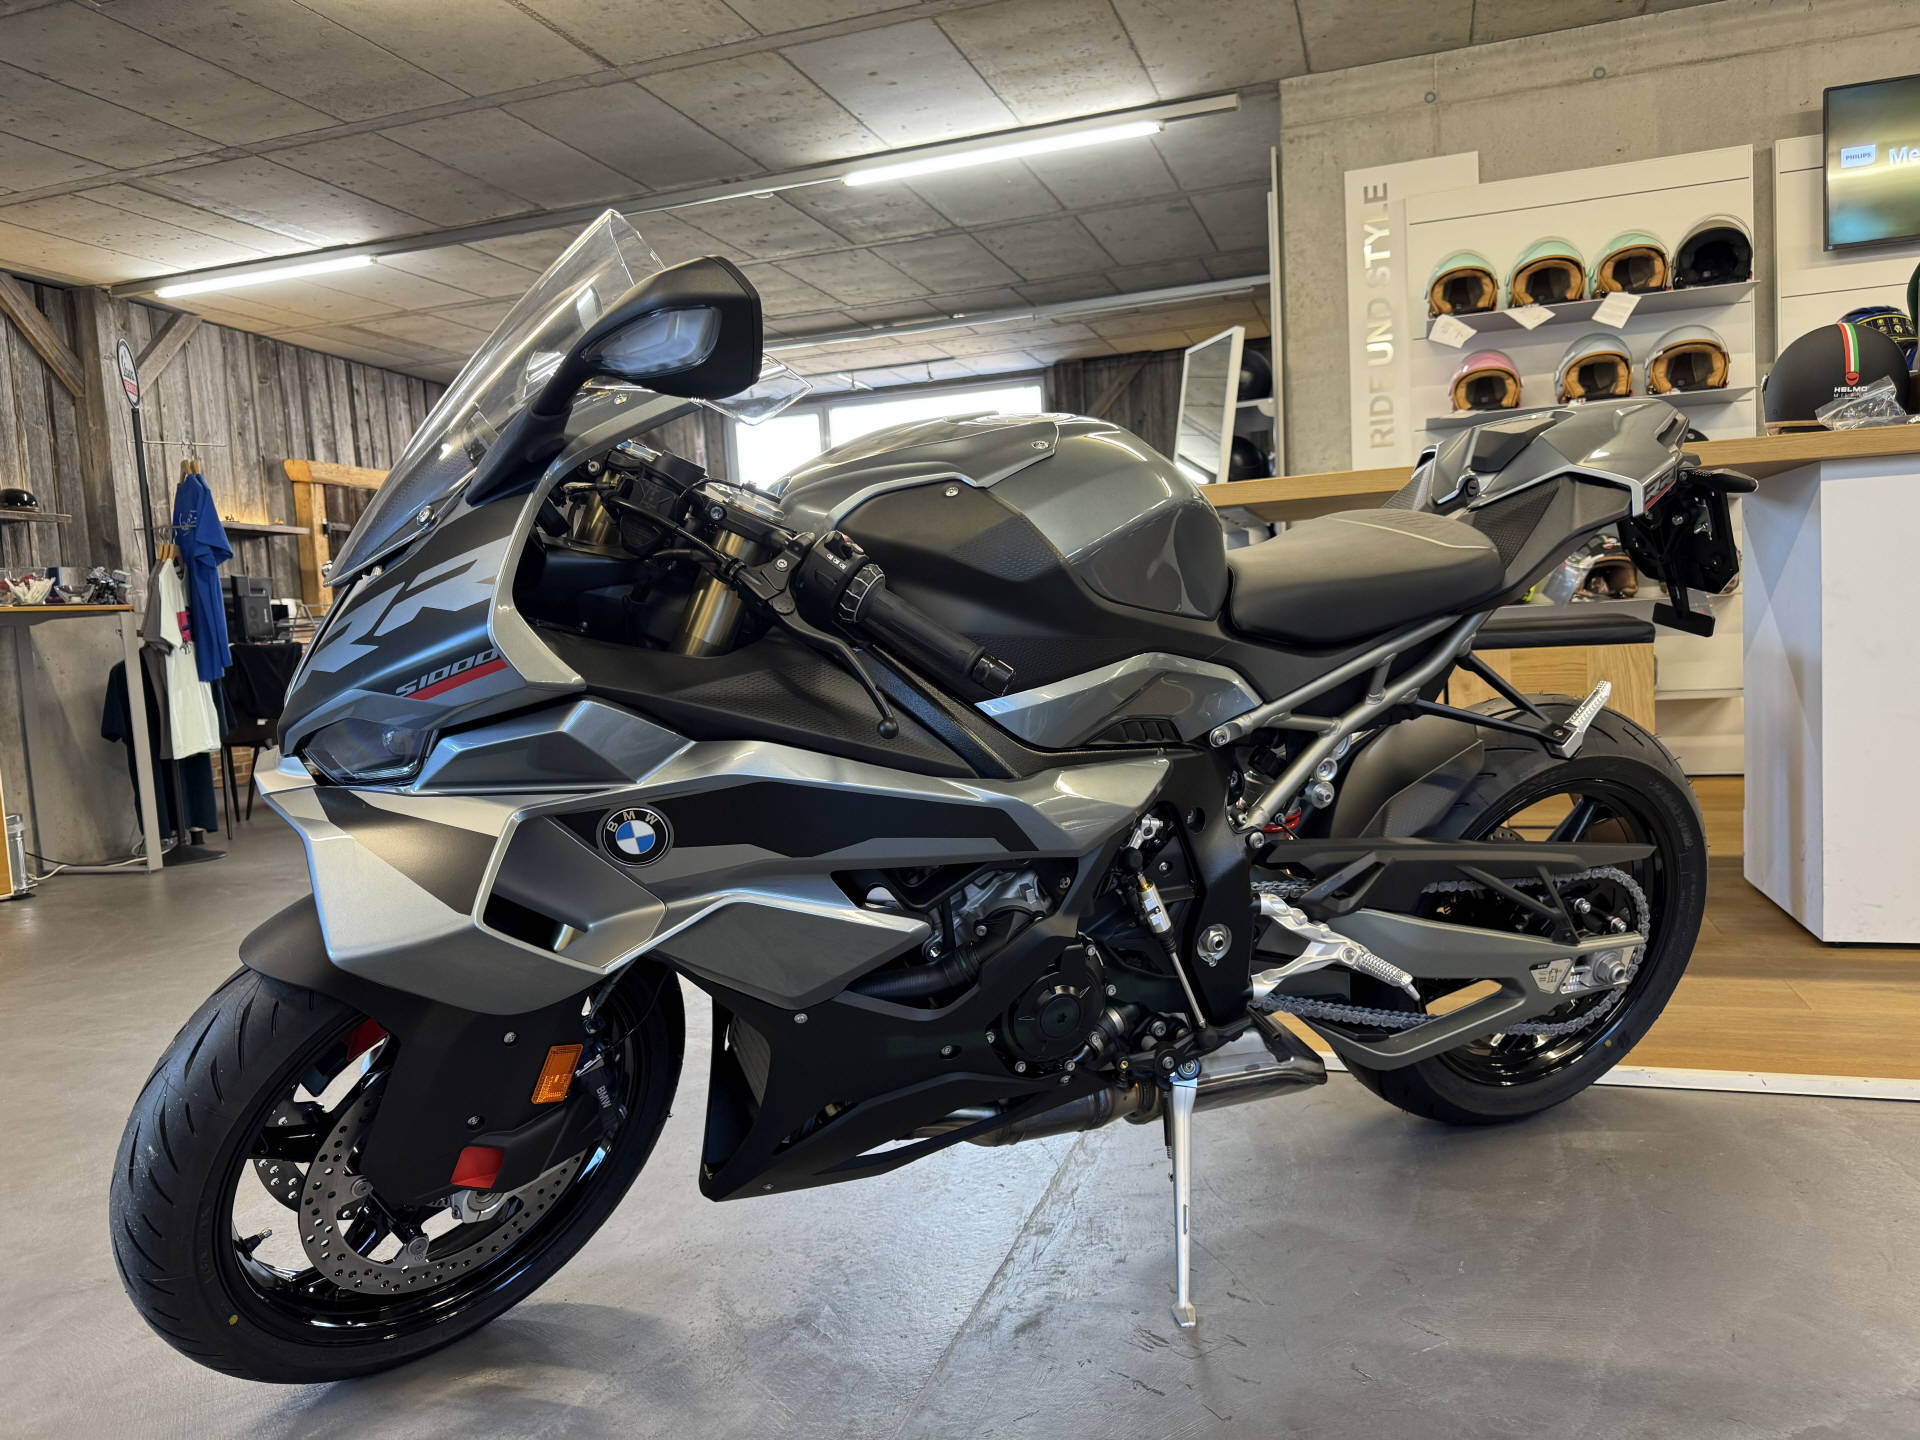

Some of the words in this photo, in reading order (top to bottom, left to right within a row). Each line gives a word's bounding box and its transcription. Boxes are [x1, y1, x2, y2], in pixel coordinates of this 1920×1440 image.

[1845, 152, 1873, 161] PHILIPS
[1888, 146, 1920, 167] Me
[1362, 183, 1392, 289] STYLE
[1366, 297, 1395, 367] UND
[1368, 375, 1395, 449] RIDE
[395, 648, 499, 698] S1000
[606, 810, 659, 833] BMW
[596, 1084, 612, 1109] BMW
